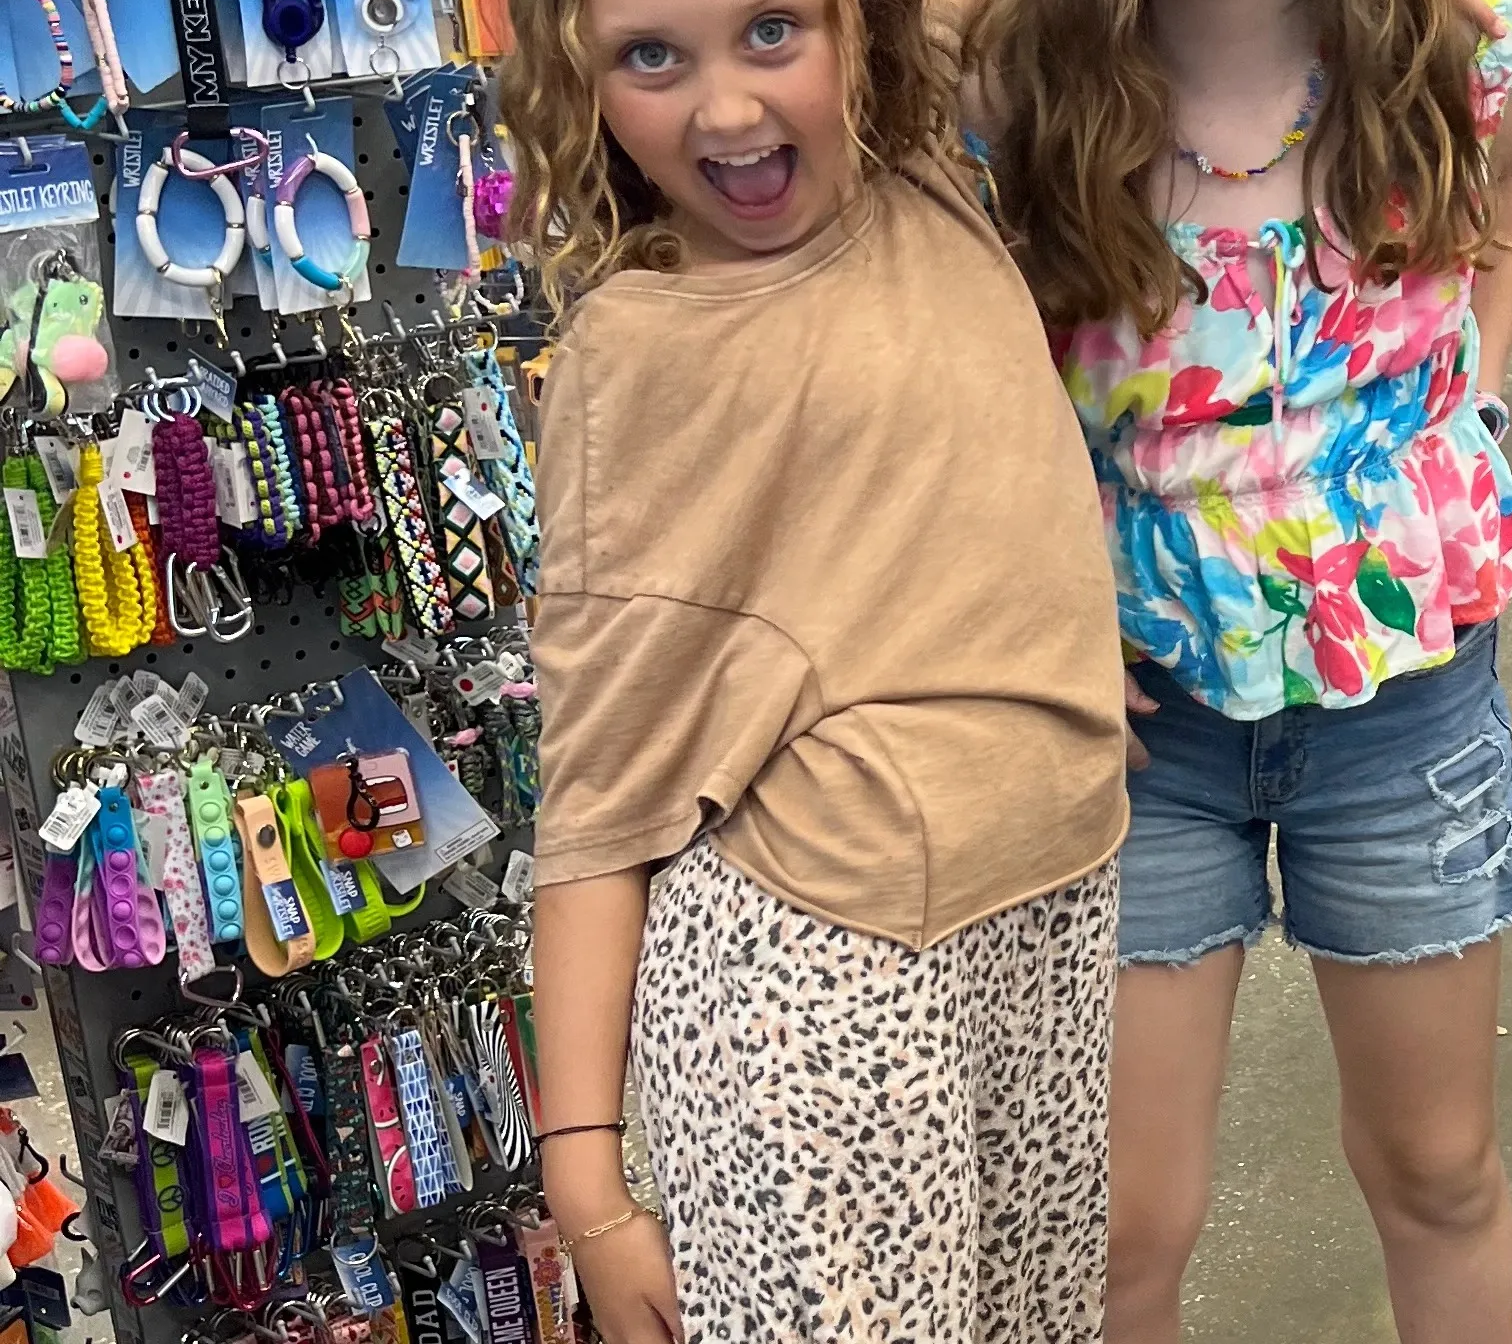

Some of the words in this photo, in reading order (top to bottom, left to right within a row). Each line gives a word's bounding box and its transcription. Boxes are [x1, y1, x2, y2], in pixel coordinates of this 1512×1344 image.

[186, 46, 220, 105] MY
[420, 96, 444, 166] WRISTLET
[269, 129, 284, 189] WRISTLET
[39, 179, 95, 209] KEYRING
[280, 721, 313, 750] WATER
[294, 732, 322, 758] GAME
[344, 869, 358, 899] SNAP
[286, 895, 300, 925] SNAP
[485, 1265, 522, 1315] QUEEN
